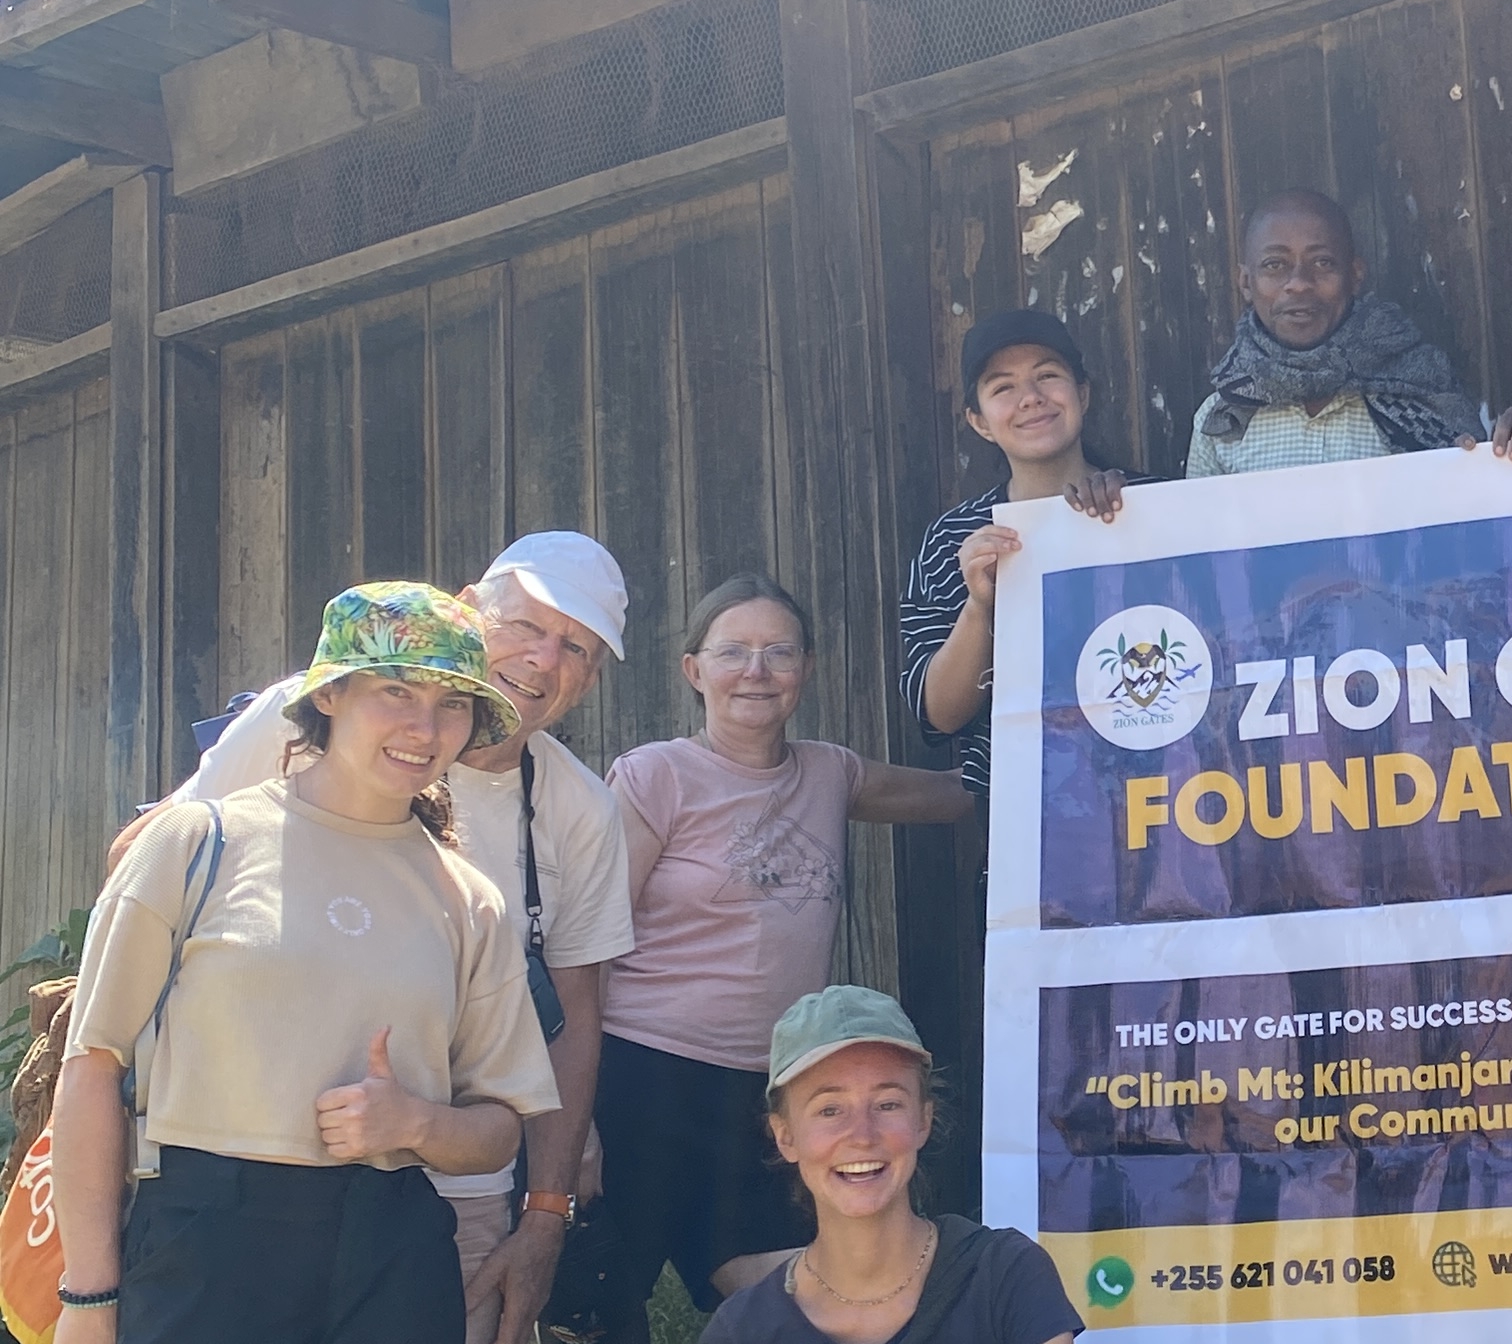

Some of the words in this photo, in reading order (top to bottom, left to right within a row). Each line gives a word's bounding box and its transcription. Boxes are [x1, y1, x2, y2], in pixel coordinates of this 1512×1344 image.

[1234, 638, 1471, 742] ZION
[1113, 717, 1138, 729] ZION
[1140, 713, 1174, 726] GATES
[1116, 1023, 1168, 1048] THE
[1174, 1017, 1248, 1045] ONLY
[1255, 1012, 1325, 1040] GATE
[1330, 1008, 1384, 1035] FOR
[1390, 998, 1512, 1030] SUCCESS
[1238, 1067, 1304, 1102] Mt:
[1274, 1118, 1340, 1145] our
[1151, 1263, 1223, 1291] +255
[1230, 1261, 1275, 1289] 621
[1283, 1258, 1334, 1287] 041
[1342, 1255, 1395, 1284] 058
